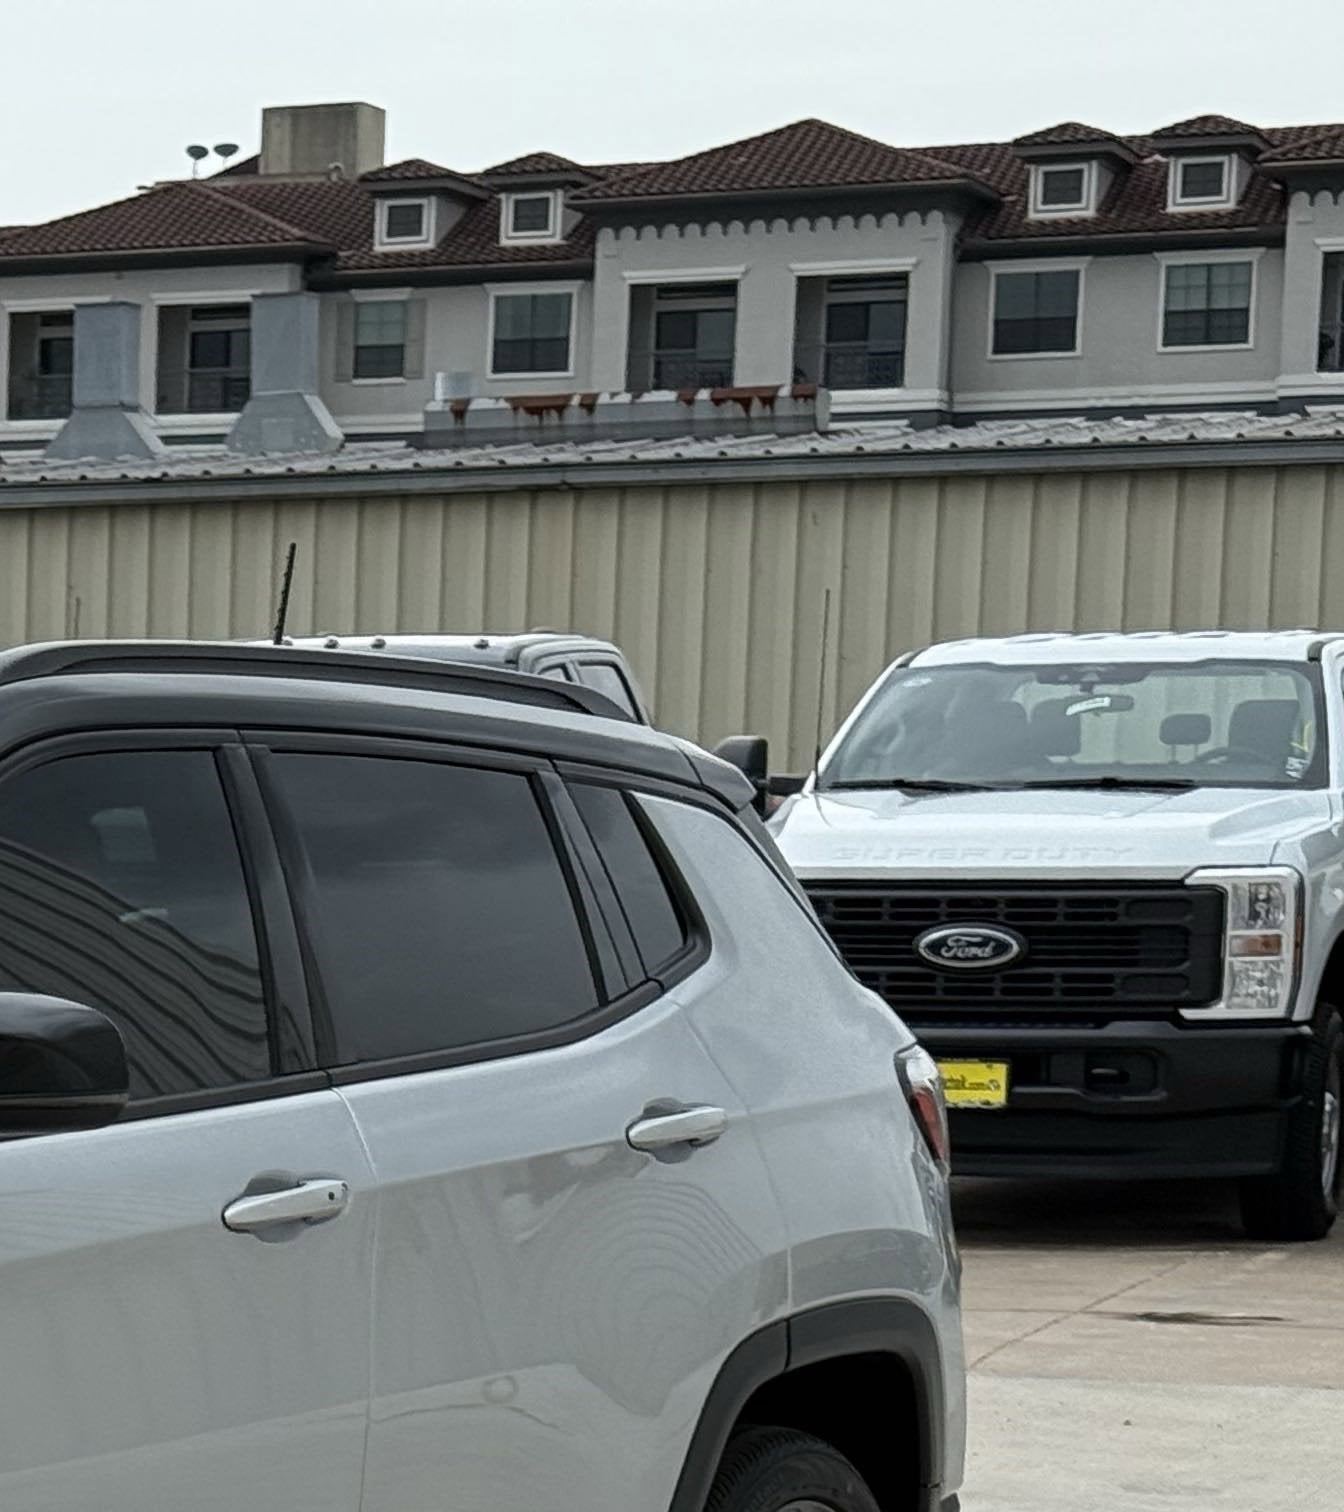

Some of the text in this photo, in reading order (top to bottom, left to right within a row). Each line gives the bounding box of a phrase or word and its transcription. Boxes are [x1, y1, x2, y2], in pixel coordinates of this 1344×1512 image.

[831, 846, 1136, 862] SUPER DUTY
[940, 935, 996, 959] Ford
